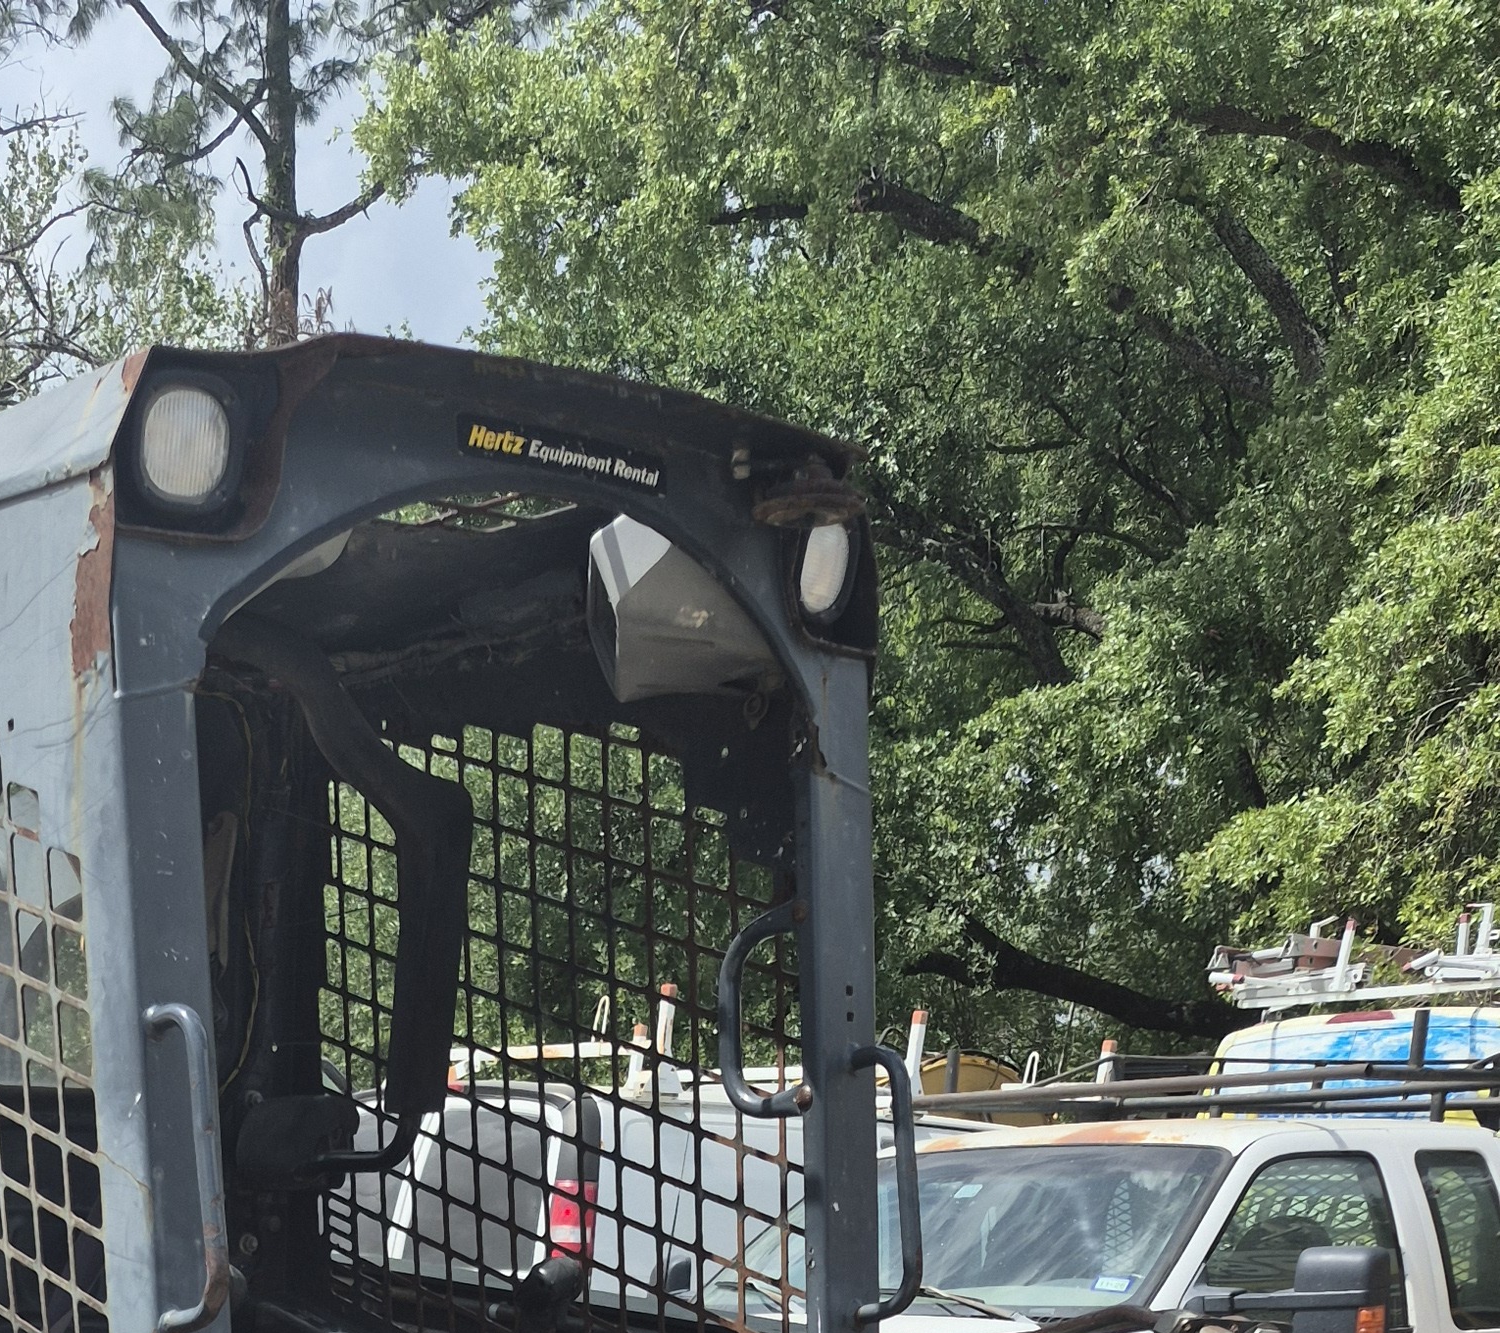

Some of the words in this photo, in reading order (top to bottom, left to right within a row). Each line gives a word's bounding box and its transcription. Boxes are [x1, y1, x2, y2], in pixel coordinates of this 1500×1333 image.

[468, 424, 526, 455] Hertz
[528, 439, 613, 475] Equipment
[613, 457, 660, 488] Rental
